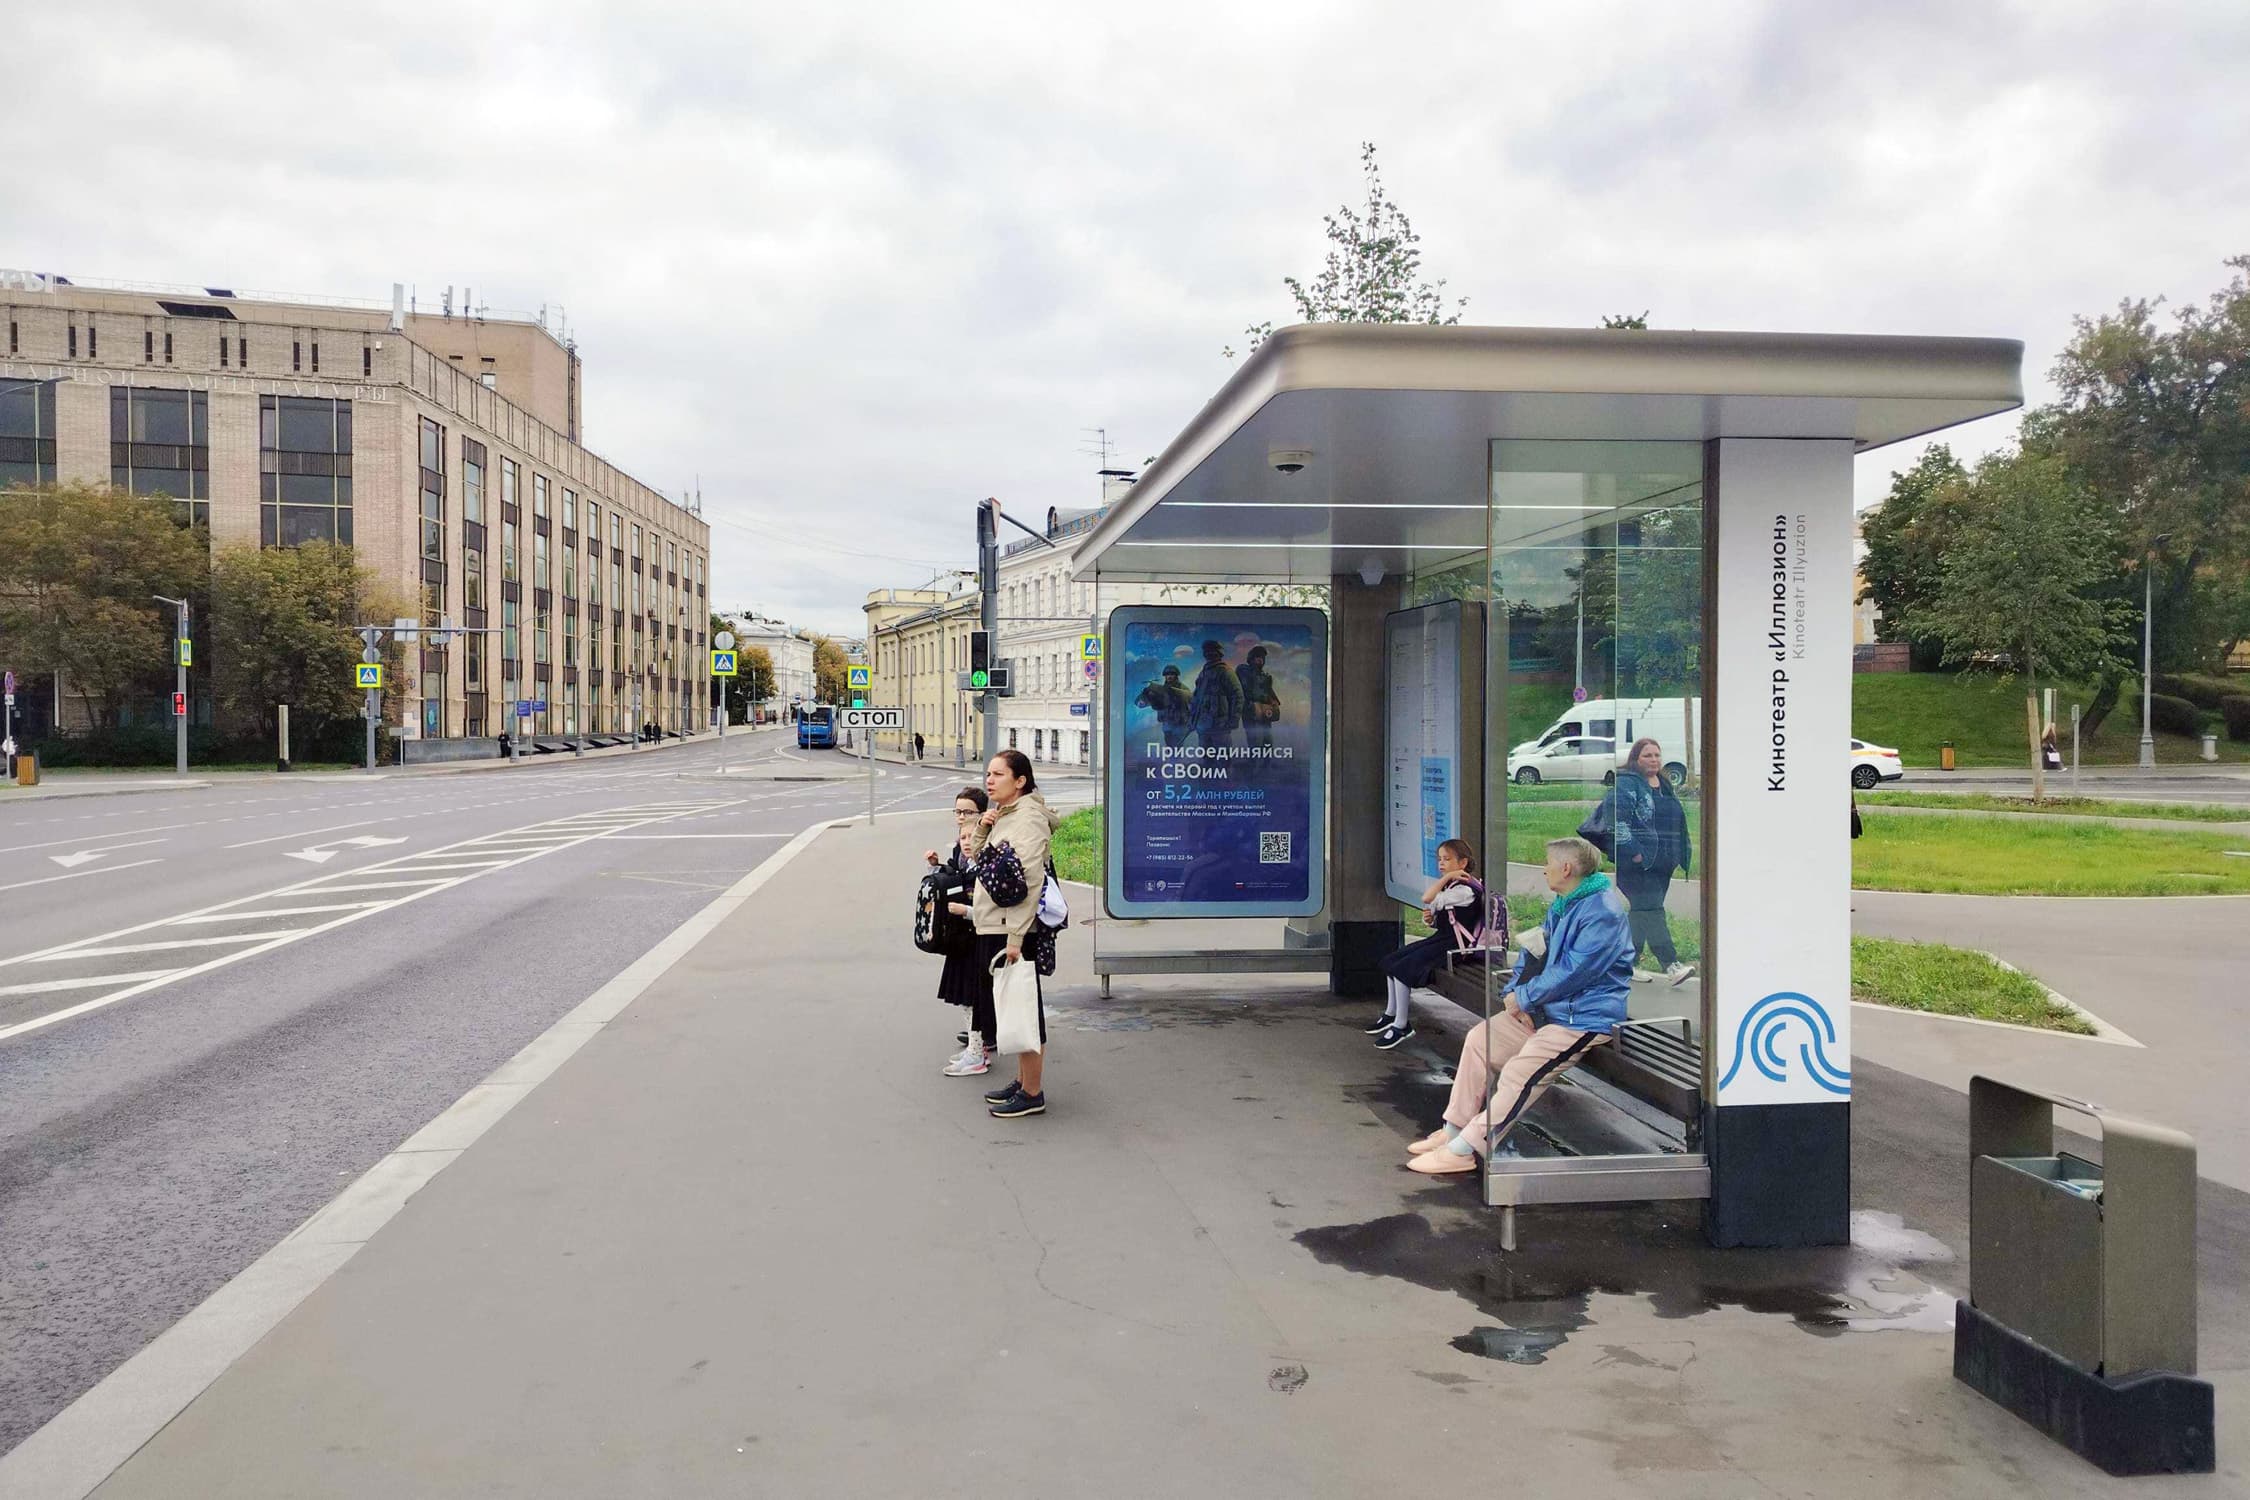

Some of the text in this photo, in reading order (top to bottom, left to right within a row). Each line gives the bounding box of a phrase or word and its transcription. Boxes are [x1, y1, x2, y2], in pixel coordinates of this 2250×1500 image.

[1792, 514, 1808, 659] Kinoteatr Illyuzion
[1768, 514, 1790, 791] Кинотеатр «Иллюзион»
[847, 711, 897, 726] СТОП
[1146, 742, 1293, 761] Присоединяйся
[1146, 763, 1228, 779] к СВОим
[1146, 784, 1265, 802] от 5,2 МЛН РУБЛЕЙ
